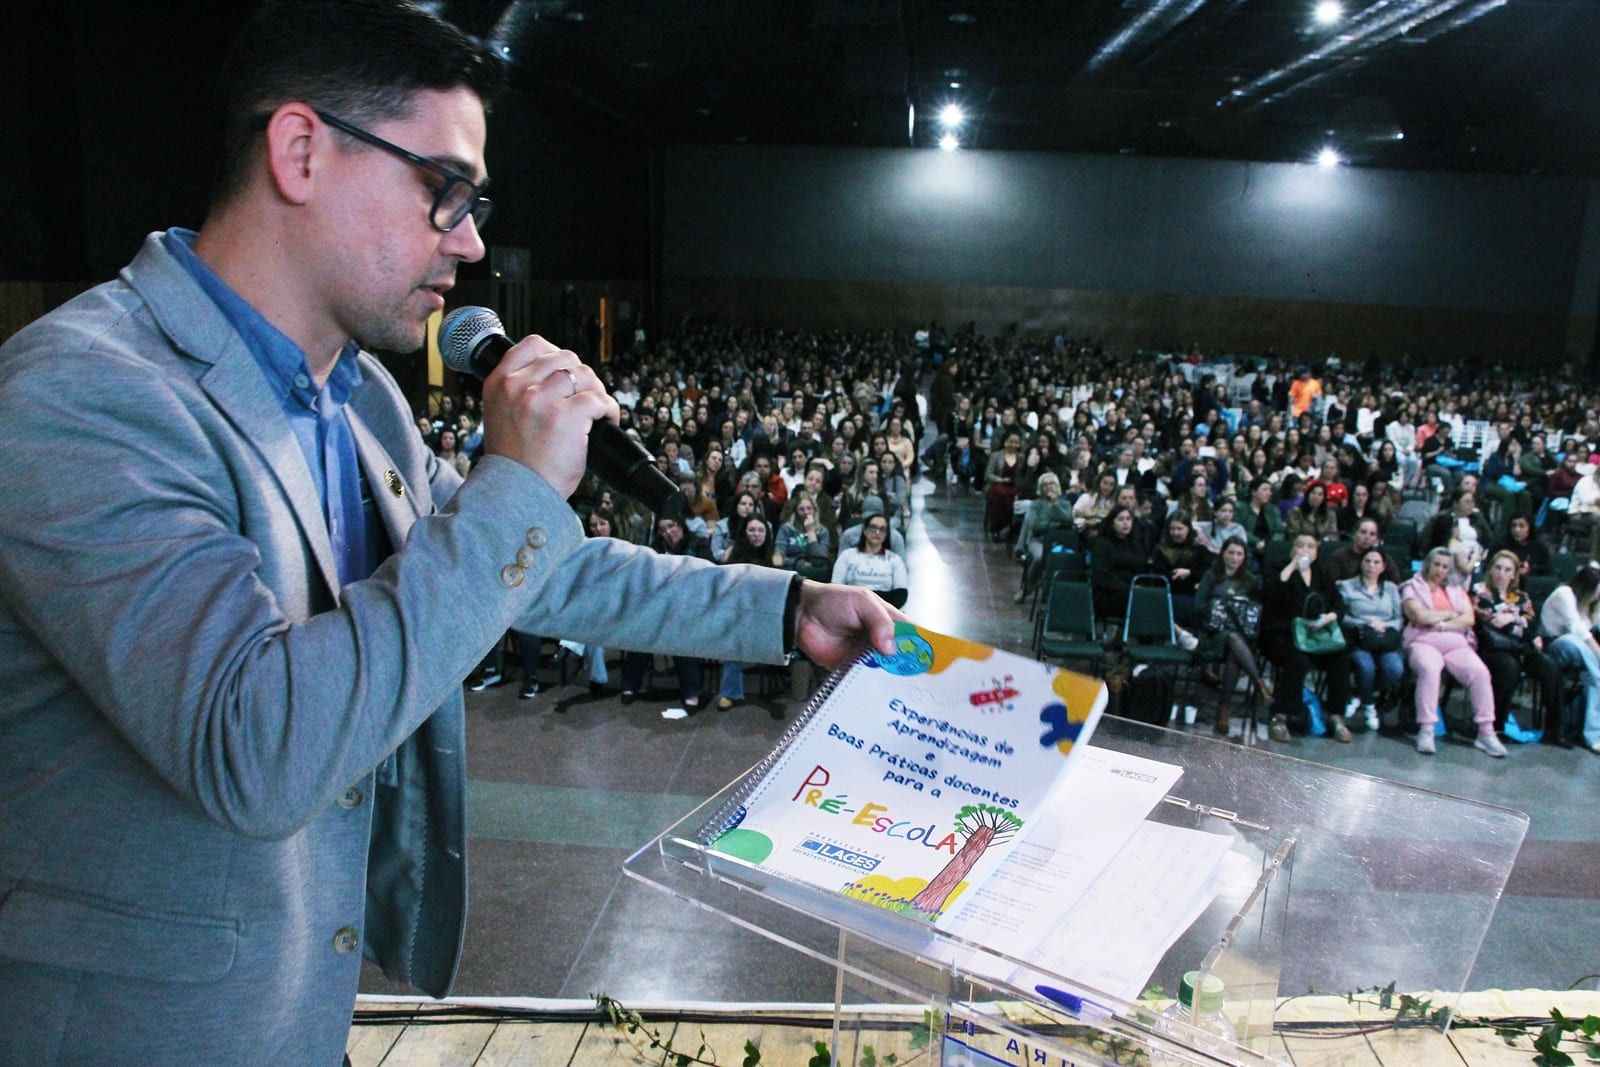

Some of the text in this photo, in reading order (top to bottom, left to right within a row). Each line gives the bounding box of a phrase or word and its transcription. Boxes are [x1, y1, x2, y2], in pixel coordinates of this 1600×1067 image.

[889, 698, 1015, 756] Experiências de
[887, 719, 1002, 768] Aprendizagem
[828, 723, 865, 750] Boas
[944, 774, 1019, 808] docentes
[925, 752, 936, 761] e
[883, 770, 942, 798] para a
[1122, 770, 1155, 782] LAG
[809, 832, 867, 854] PREFEITURA
[820, 846, 876, 869] LAGES
